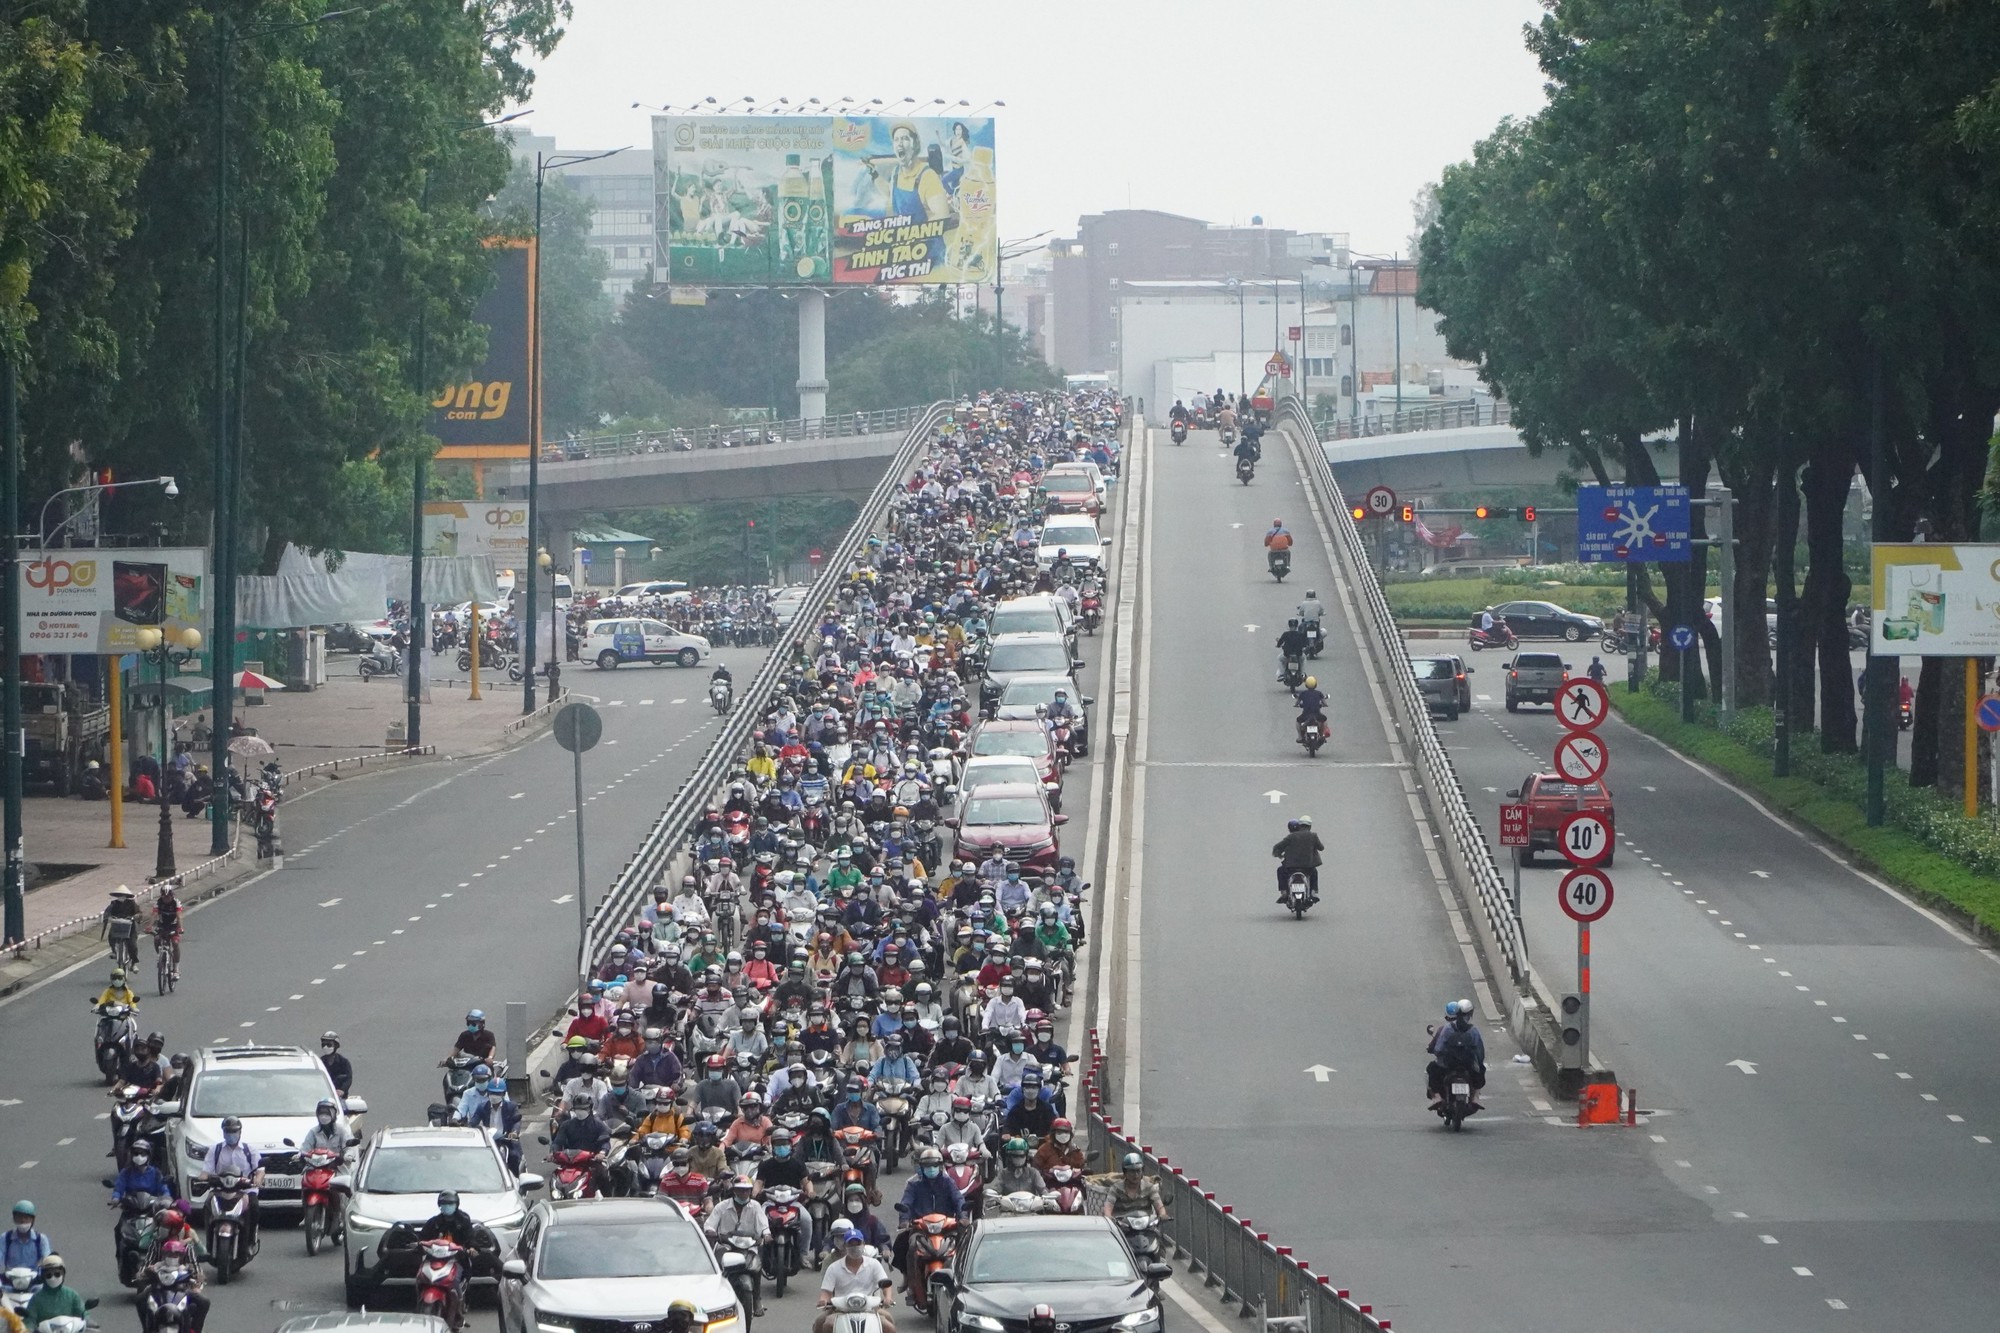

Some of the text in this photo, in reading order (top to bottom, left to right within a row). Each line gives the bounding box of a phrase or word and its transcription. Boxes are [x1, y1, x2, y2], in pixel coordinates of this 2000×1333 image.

[884, 215, 912, 228] THÊM
[865, 221, 944, 246] SỨC MẠNH
[880, 258, 932, 280] TỨC THÌ
[444, 411, 477, 420] .com
[1375, 495, 1388, 508] 30
[1403, 508, 1412, 521] 6
[1525, 508, 1535, 521] 6
[1573, 882, 1597, 906] 40
